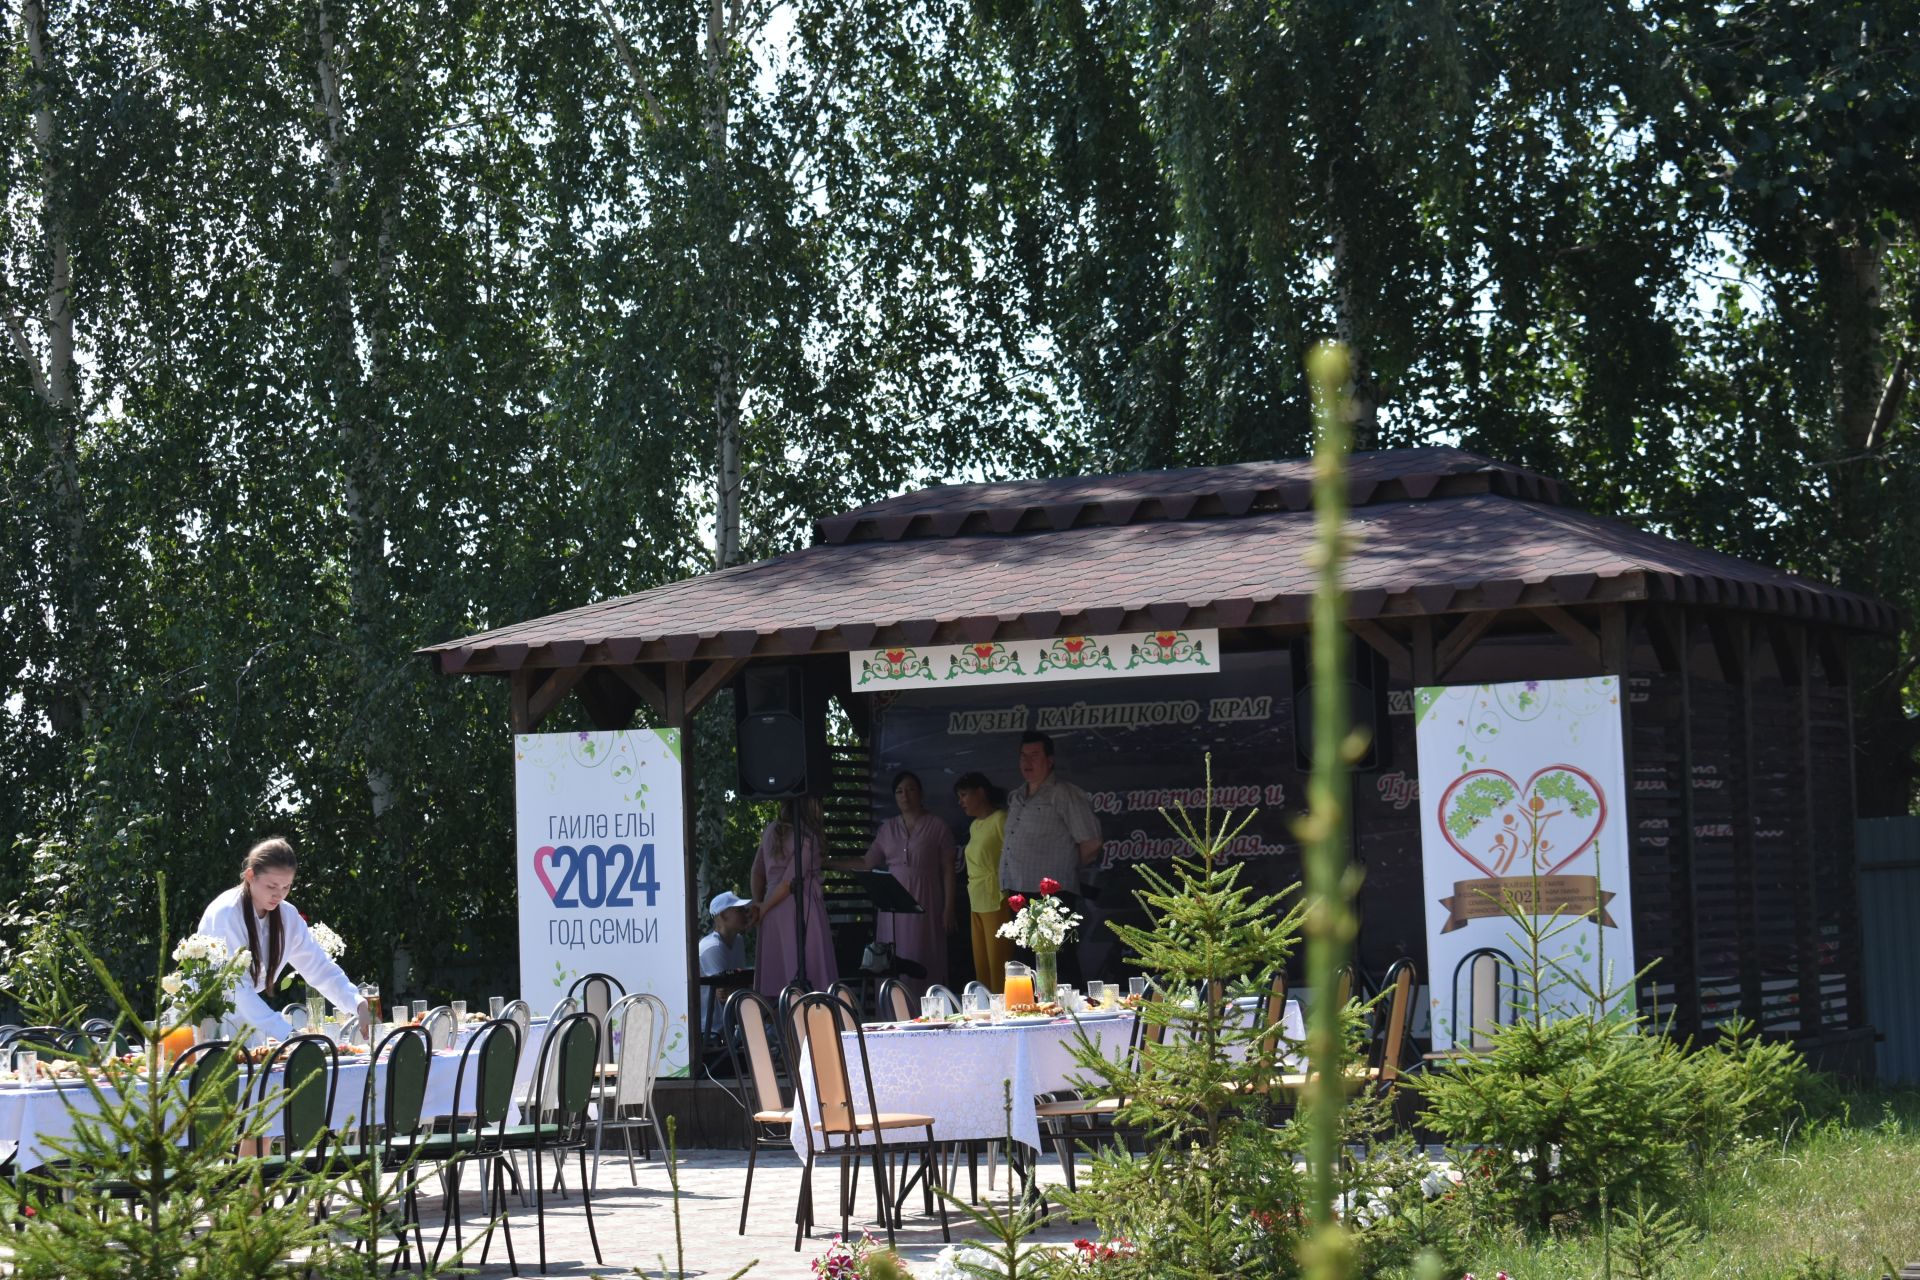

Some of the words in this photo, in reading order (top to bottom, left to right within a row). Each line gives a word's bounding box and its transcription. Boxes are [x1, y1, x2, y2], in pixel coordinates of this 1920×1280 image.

[949, 705, 1028, 734] МУЗЕЙ
[1037, 701, 1200, 730] КАЙБИЦКОГО
[1209, 697, 1272, 722] КРАЯ
[1265, 784, 1285, 805] и
[549, 813, 608, 840] ГАИЛӘ
[615, 812, 655, 838] ЕЛЫ
[1101, 829, 1196, 868] родного
[1210, 835, 1285, 865] рая...
[551, 843, 661, 909] 2024
[549, 919, 585, 951] ГОД
